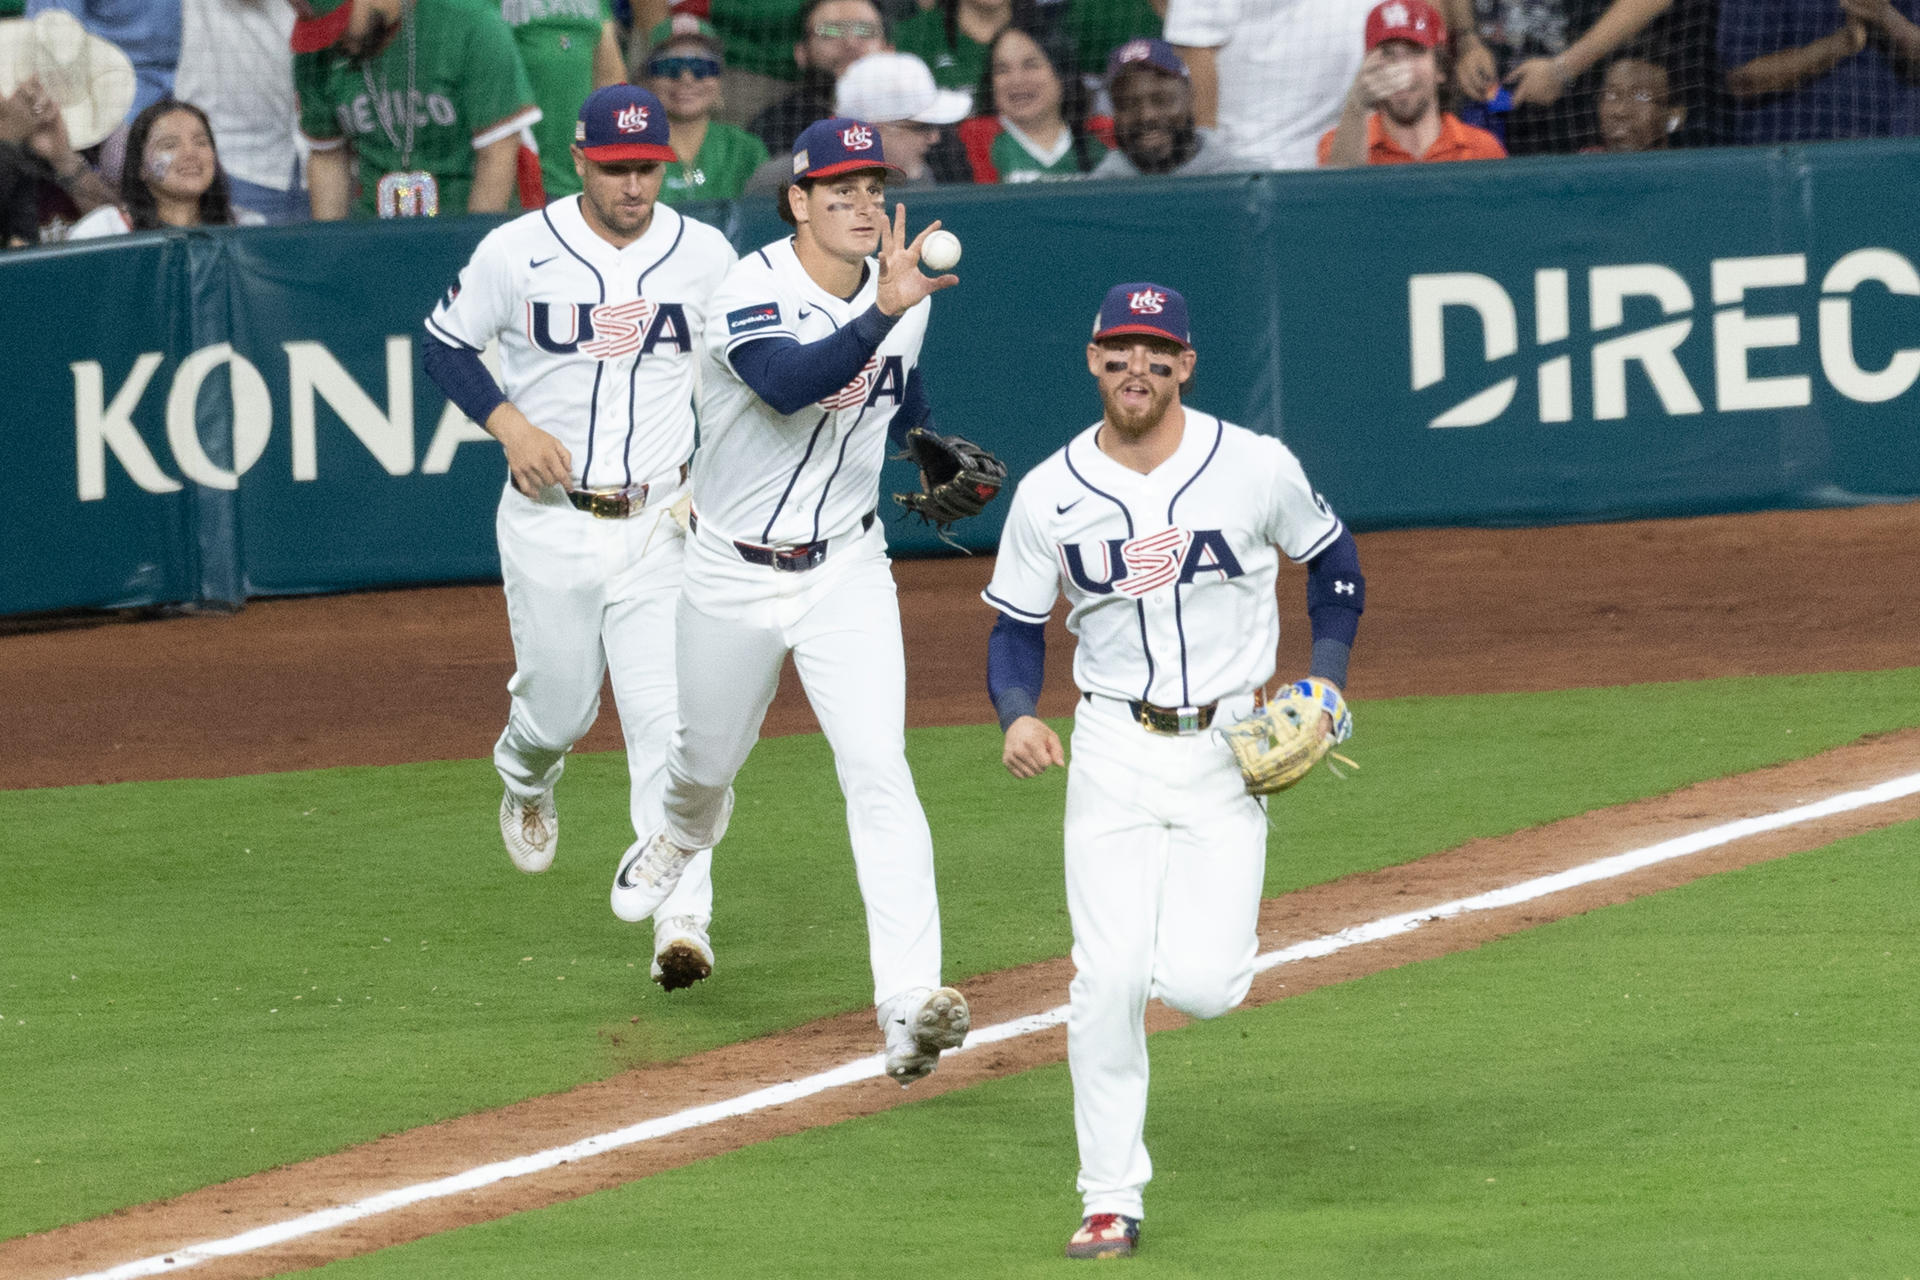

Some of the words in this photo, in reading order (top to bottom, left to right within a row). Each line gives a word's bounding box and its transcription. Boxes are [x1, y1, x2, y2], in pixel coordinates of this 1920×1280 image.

[526, 299, 692, 357] USA
[1408, 247, 1920, 428] DIREC
[818, 352, 905, 411] SA
[1057, 527, 1245, 596] USA
